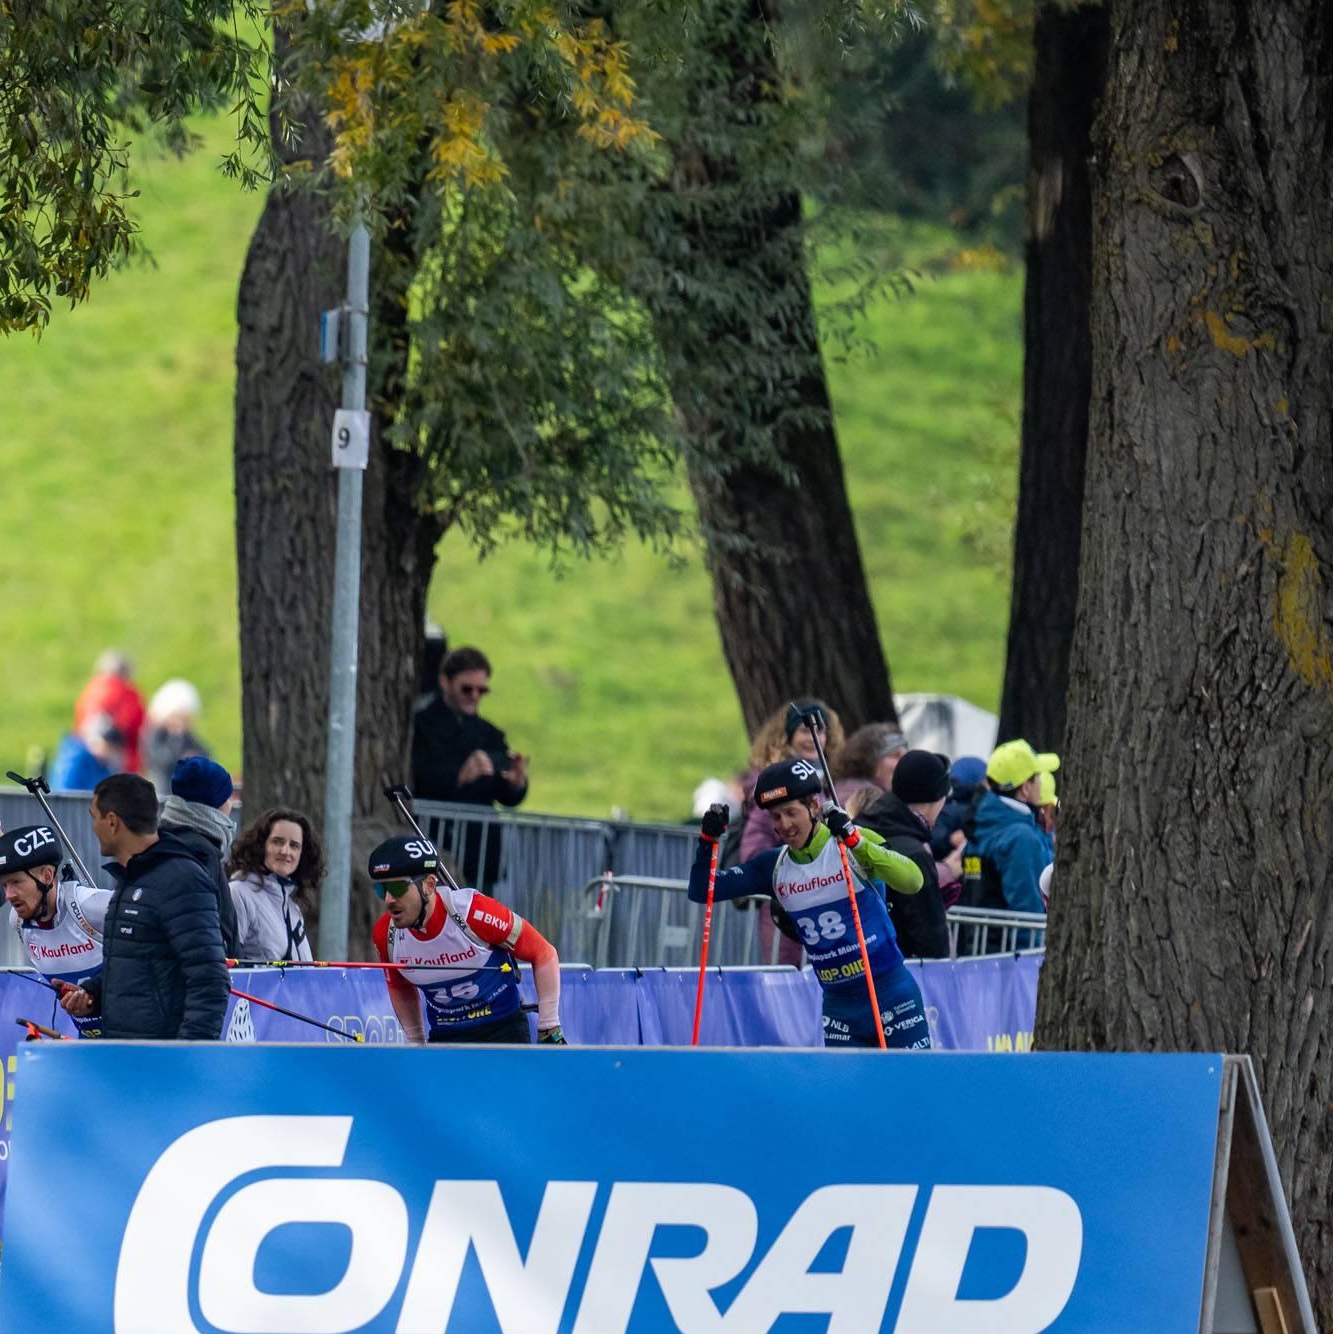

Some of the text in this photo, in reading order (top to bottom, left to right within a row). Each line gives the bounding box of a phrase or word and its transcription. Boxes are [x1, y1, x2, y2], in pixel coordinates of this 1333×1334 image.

[337, 427, 351, 449] 9
[13, 827, 55, 857] CZE
[789, 869, 844, 894] Kaufland
[484, 913, 509, 931] BKW
[796, 910, 847, 946] 38
[41, 938, 95, 959] Kaufland
[837, 933, 877, 956] Müncen
[830, 1019, 850, 1034] NLB
[893, 1014, 925, 1031] VERIGA
